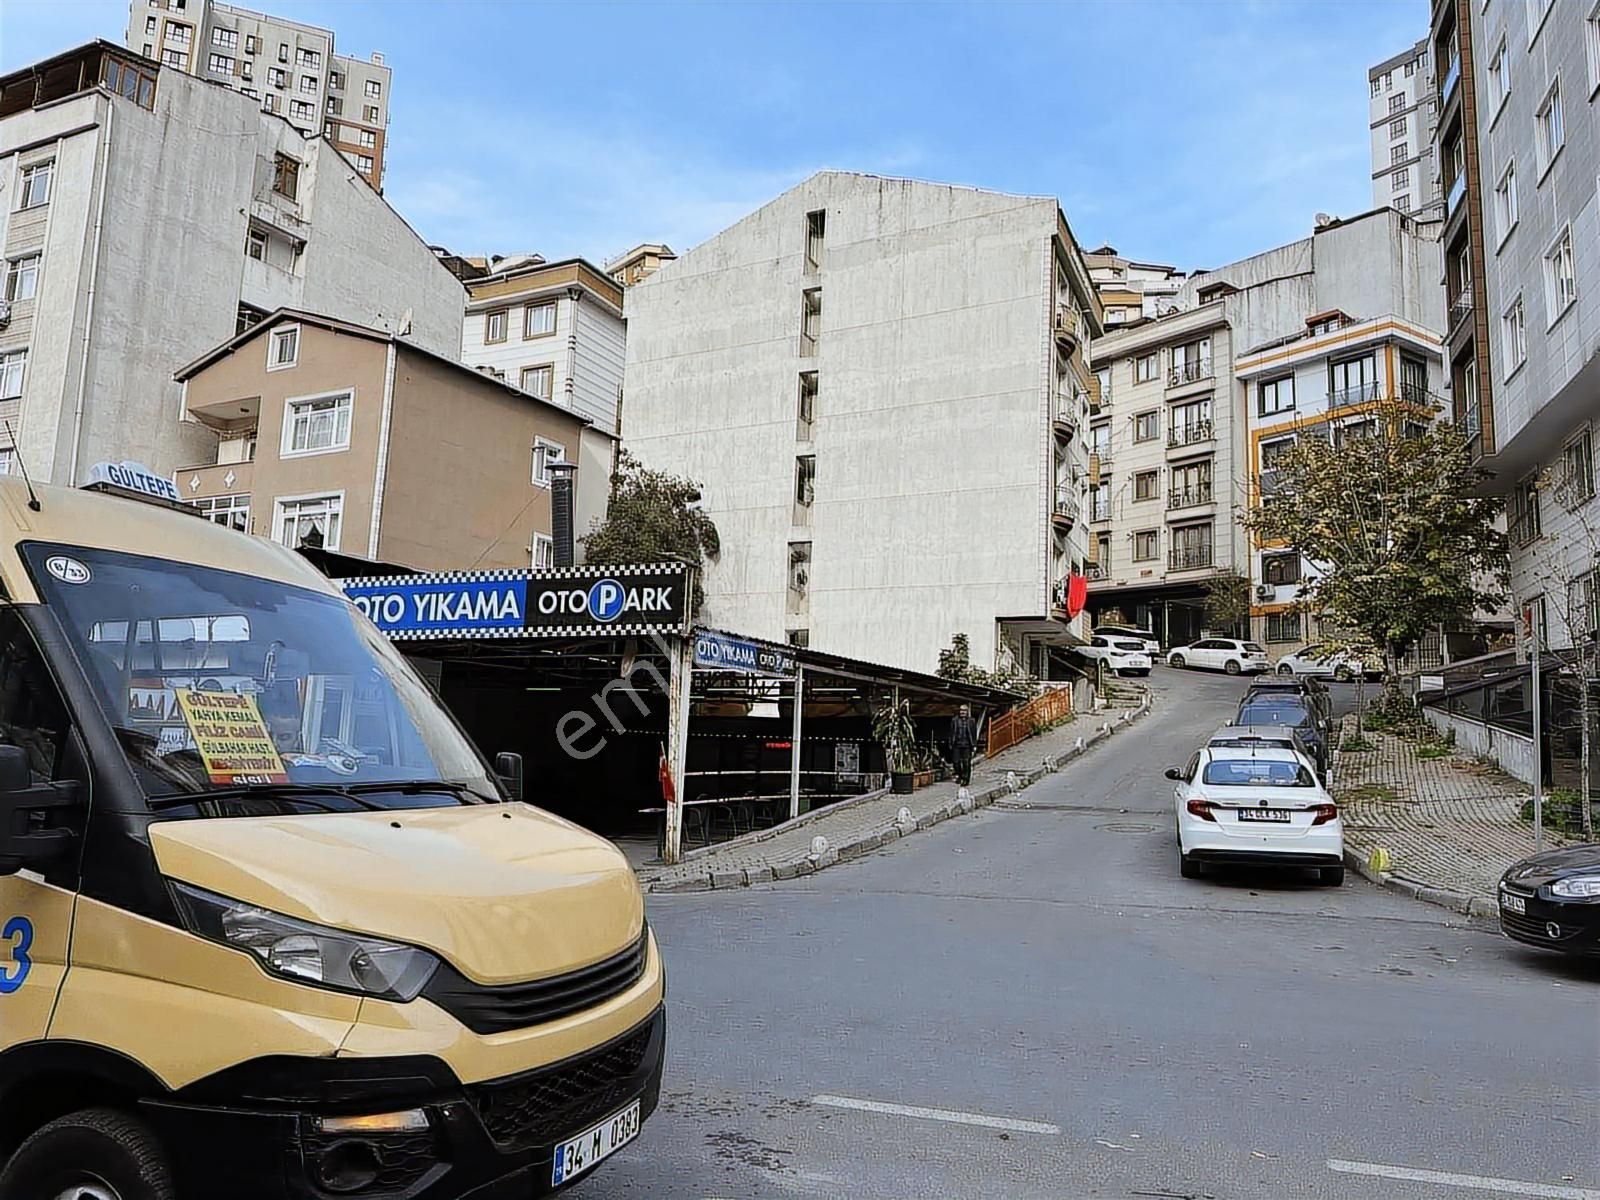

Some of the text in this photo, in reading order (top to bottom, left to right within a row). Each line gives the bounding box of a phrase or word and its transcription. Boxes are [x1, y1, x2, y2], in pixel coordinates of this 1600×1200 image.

[107, 465, 177, 499] GÜLTEPE
[354, 589, 520, 623] OTO YIKAMA
[697, 640, 756, 665] OTO YIKAMA
[186, 692, 250, 709] GÜLTEPE
[189, 708, 258, 723] YAHYA KEMAL
[565, 1140, 584, 1175] 34
[610, 1106, 639, 1148] 0383
